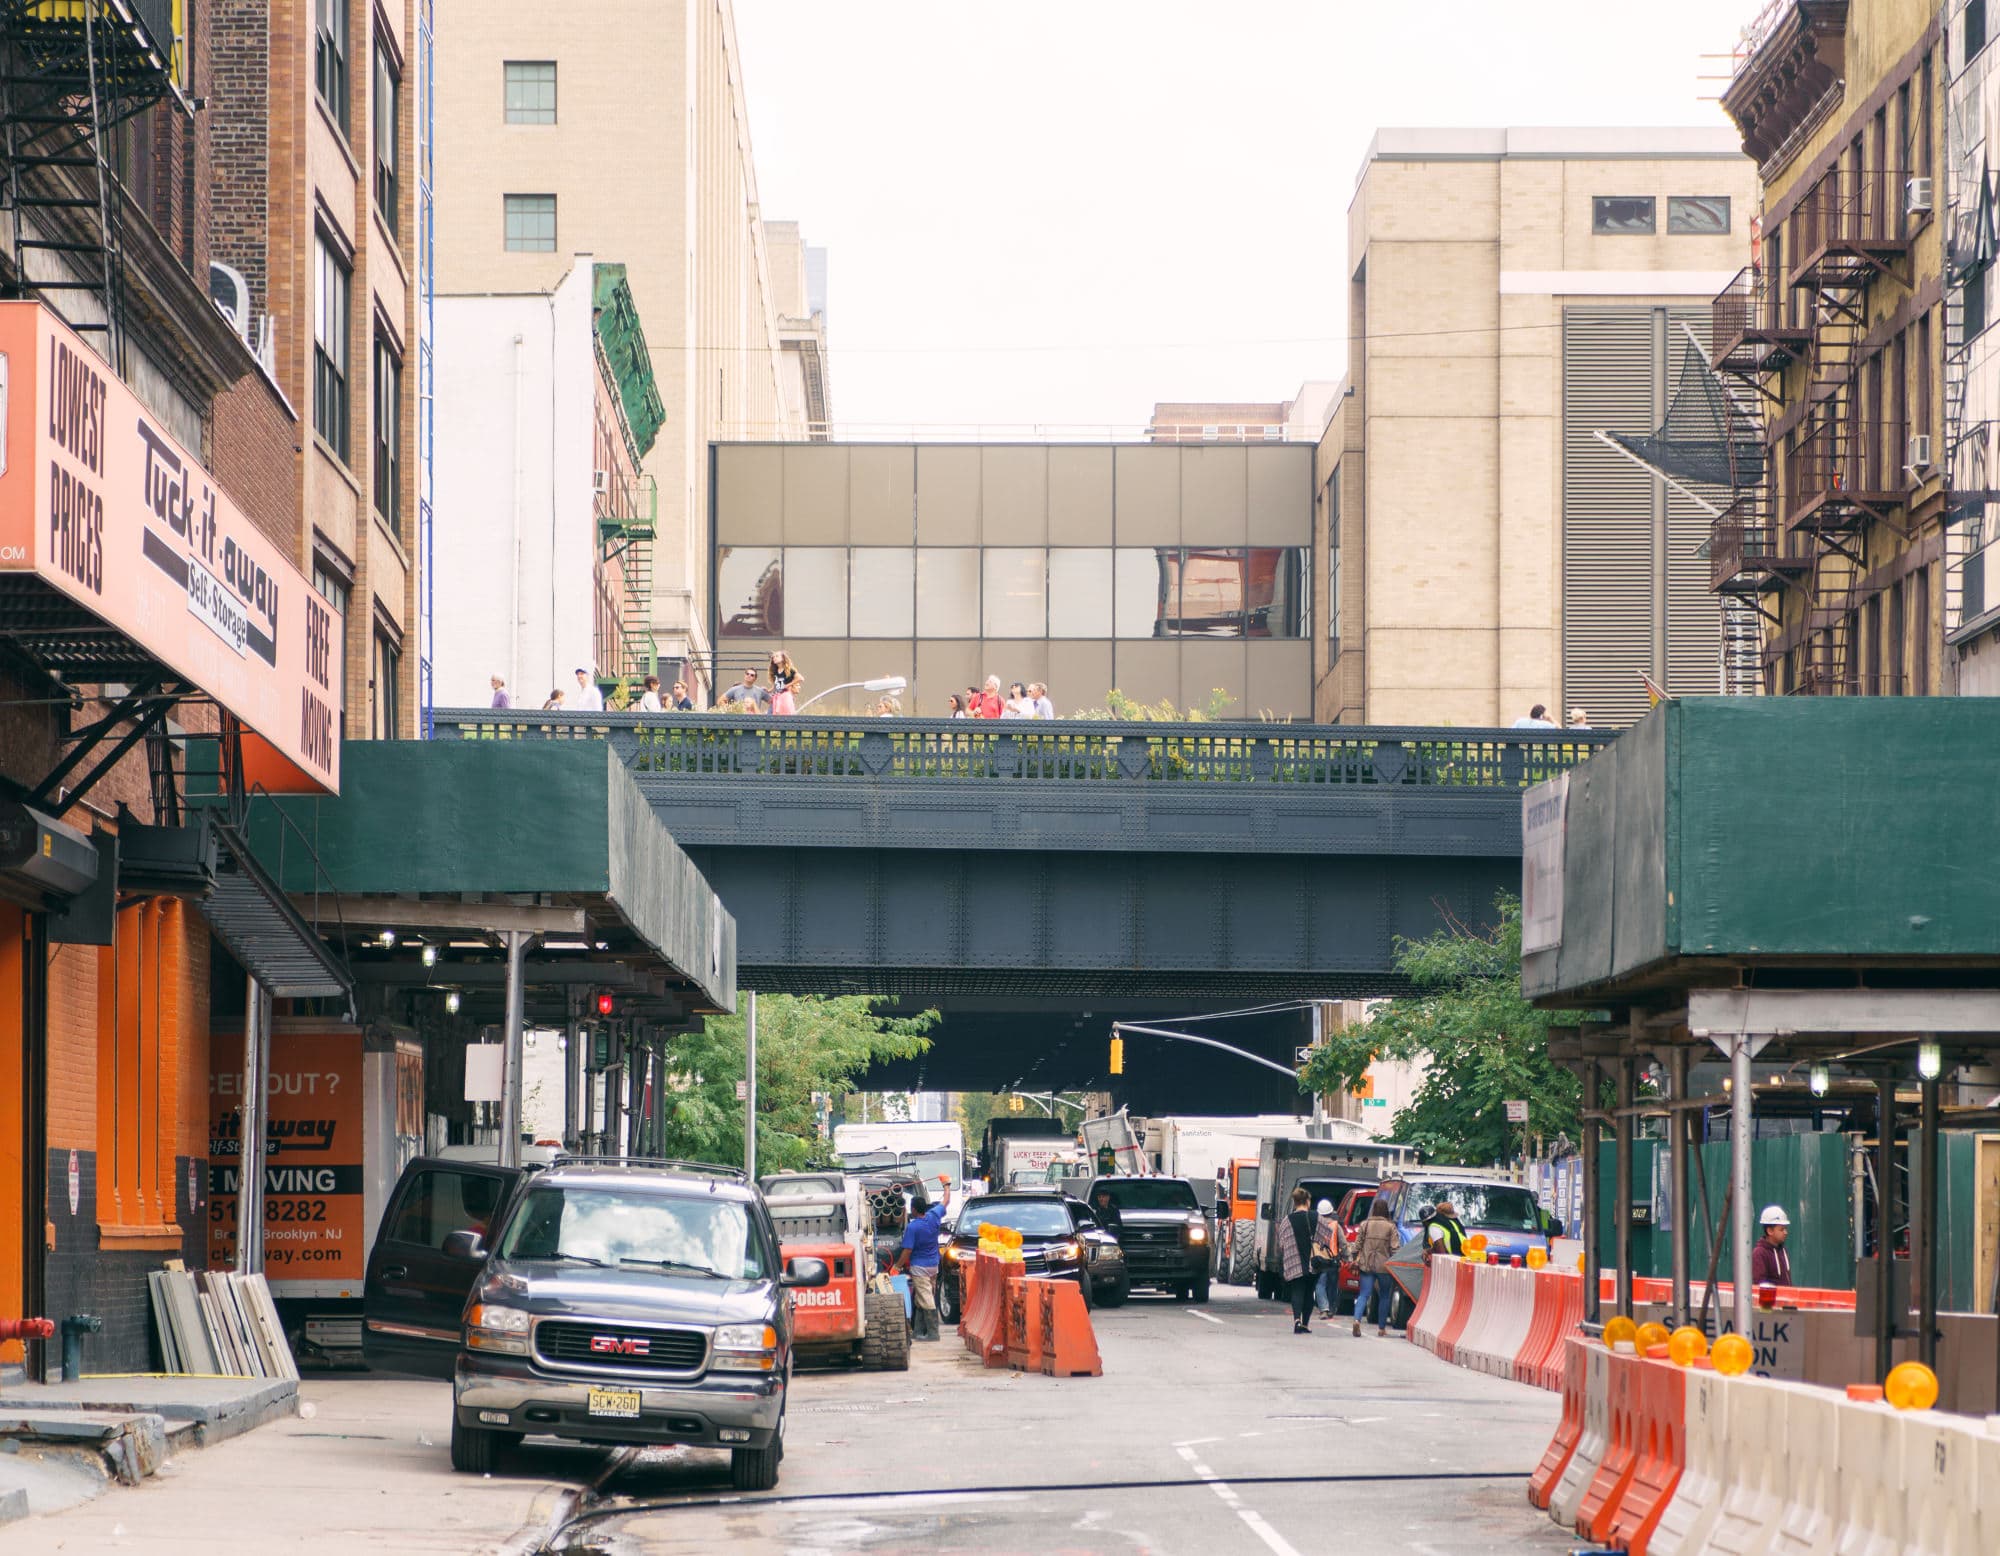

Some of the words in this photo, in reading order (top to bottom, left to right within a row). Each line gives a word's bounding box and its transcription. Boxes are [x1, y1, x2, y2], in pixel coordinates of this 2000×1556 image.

[49, 334, 106, 479] LOWEST
[50, 460, 103, 596] PRICES
[306, 594, 330, 691] FREE
[301, 685, 332, 777] MOVING
[224, 1169, 336, 1192] MVING
[264, 1228, 317, 1242] Brooklyn
[325, 1228, 342, 1240] NJ
[590, 1336, 650, 1355] GMC
